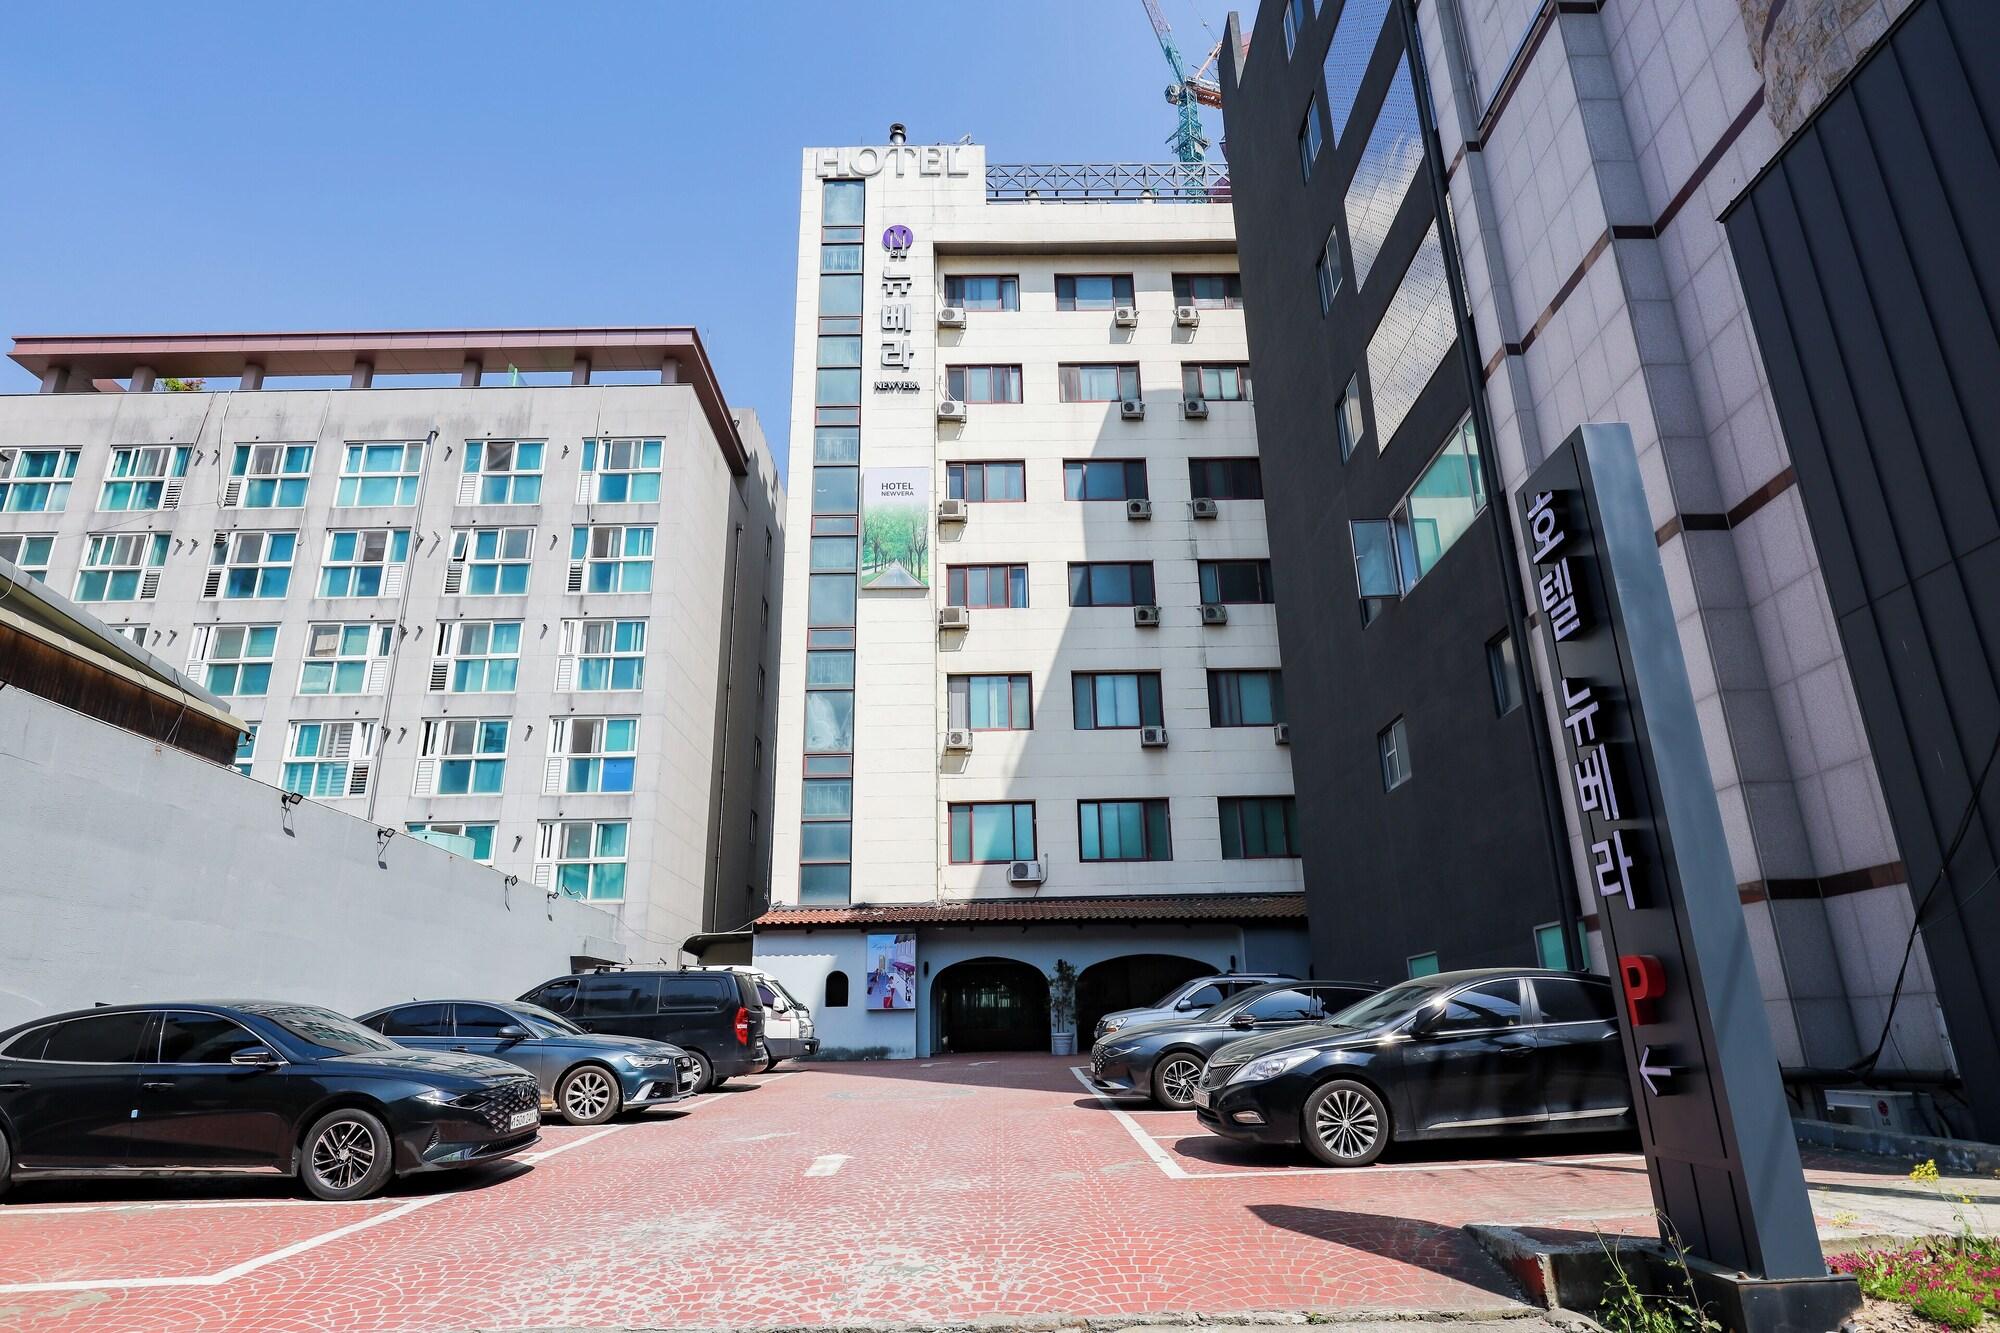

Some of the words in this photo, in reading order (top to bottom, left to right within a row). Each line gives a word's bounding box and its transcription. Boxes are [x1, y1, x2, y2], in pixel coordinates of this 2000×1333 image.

[815, 148, 969, 178] HOTEL
[881, 266, 914, 371] 뉴베라
[874, 381, 920, 391] NEWVERA
[881, 482, 914, 491] HOTEL
[1528, 491, 1581, 642] 호텔
[1561, 677, 1636, 910] 뉴베라
[1617, 954, 1650, 1028] P
